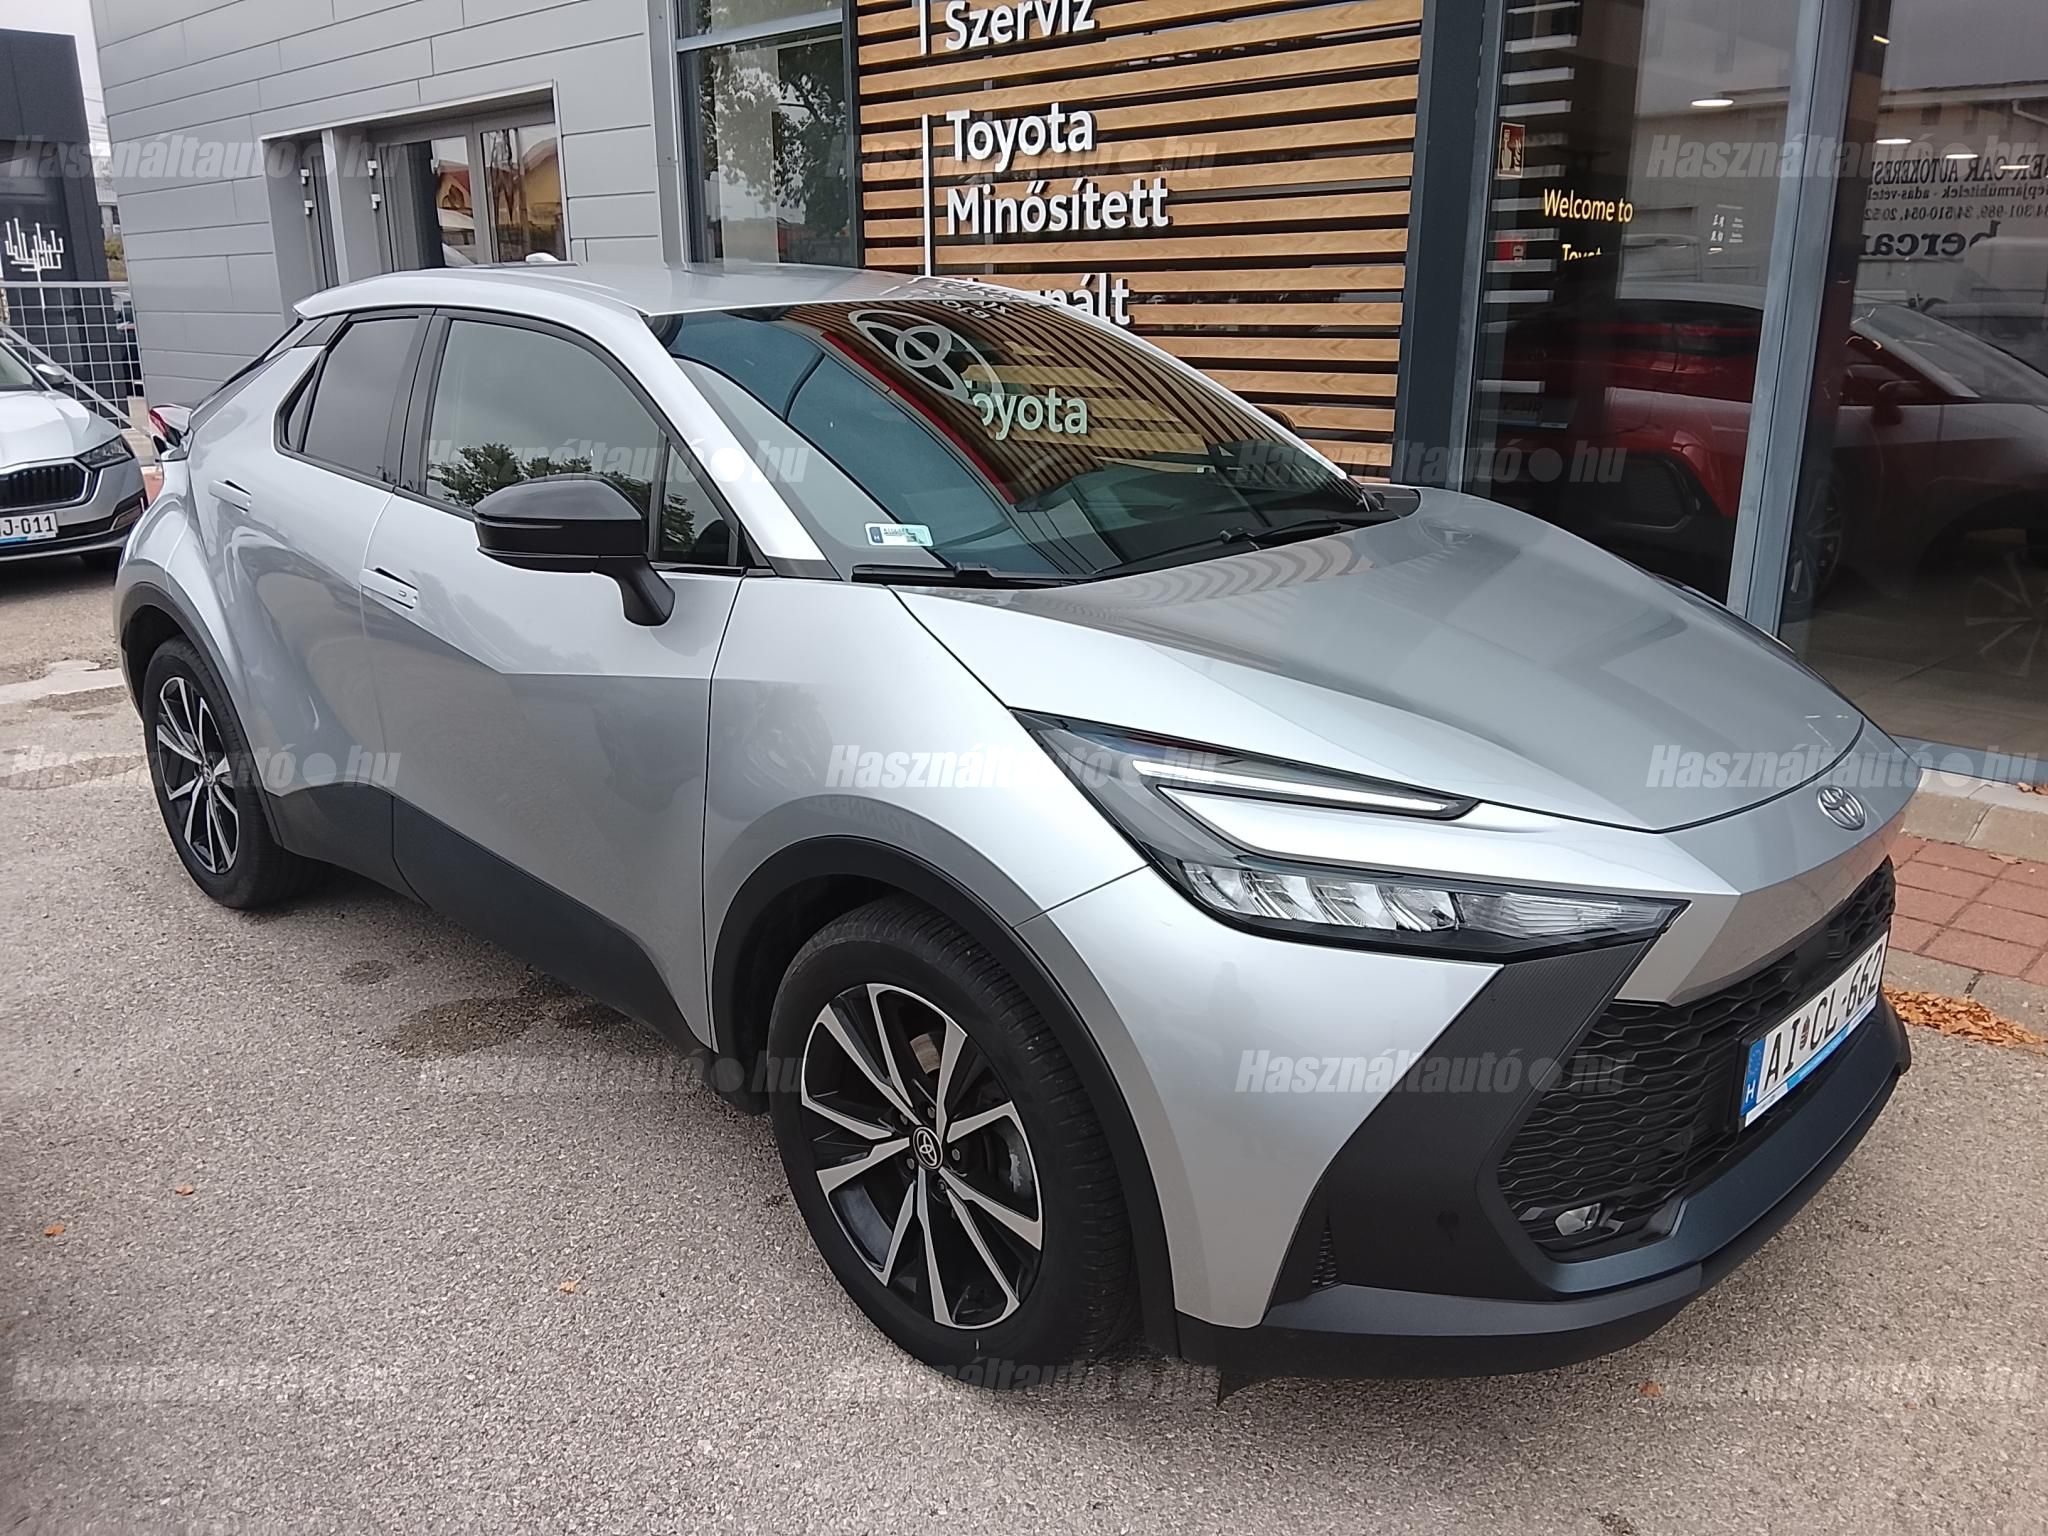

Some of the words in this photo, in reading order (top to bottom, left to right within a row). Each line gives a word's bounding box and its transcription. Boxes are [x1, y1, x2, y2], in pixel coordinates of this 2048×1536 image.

[945, 0, 1096, 51] Szerviz
[946, 102, 1095, 172] Toyota
[947, 177, 1170, 235] Minősített
[1543, 188, 1615, 222] Welcome
[1618, 197, 1634, 223] to
[1763, 1018, 1801, 1091] AI
[1810, 943, 1884, 1051] CL-662
[1745, 1081, 1756, 1104] H
